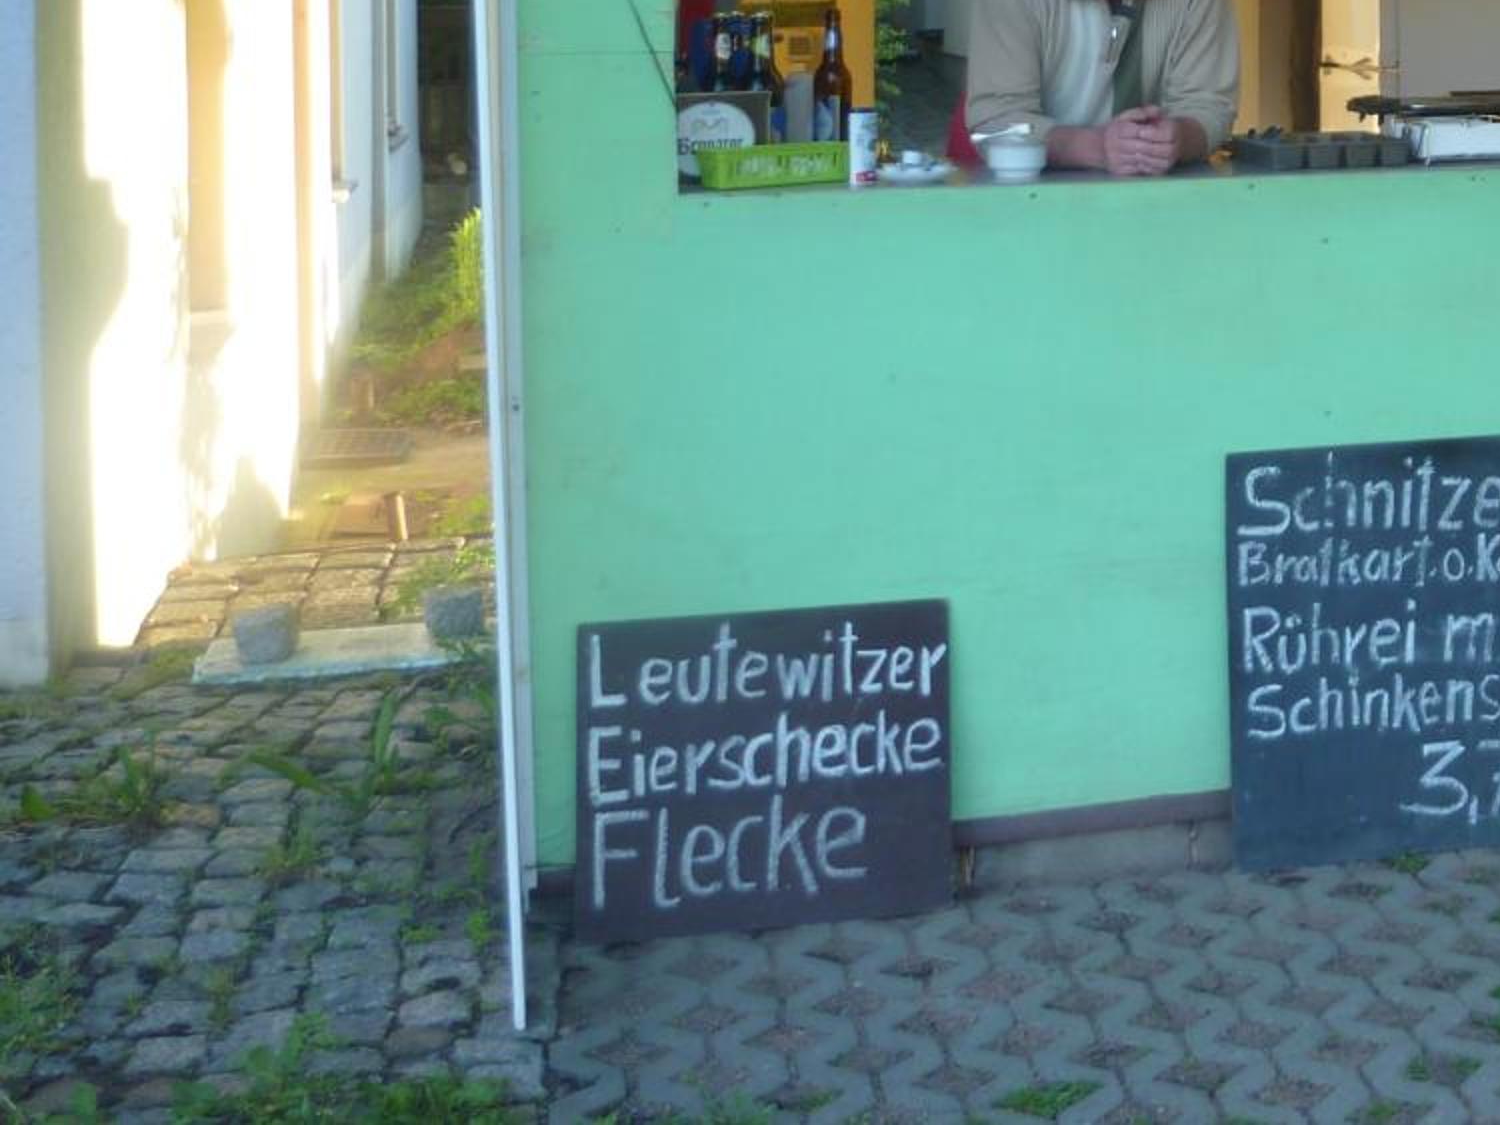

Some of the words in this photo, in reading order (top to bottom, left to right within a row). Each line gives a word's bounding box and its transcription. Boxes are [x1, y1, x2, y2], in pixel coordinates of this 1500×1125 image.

[589, 620, 947, 708] Leutewitzer
[1243, 599, 1418, 674] Rührei
[588, 708, 944, 807] Eierschecke
[593, 793, 868, 910] Flecke
